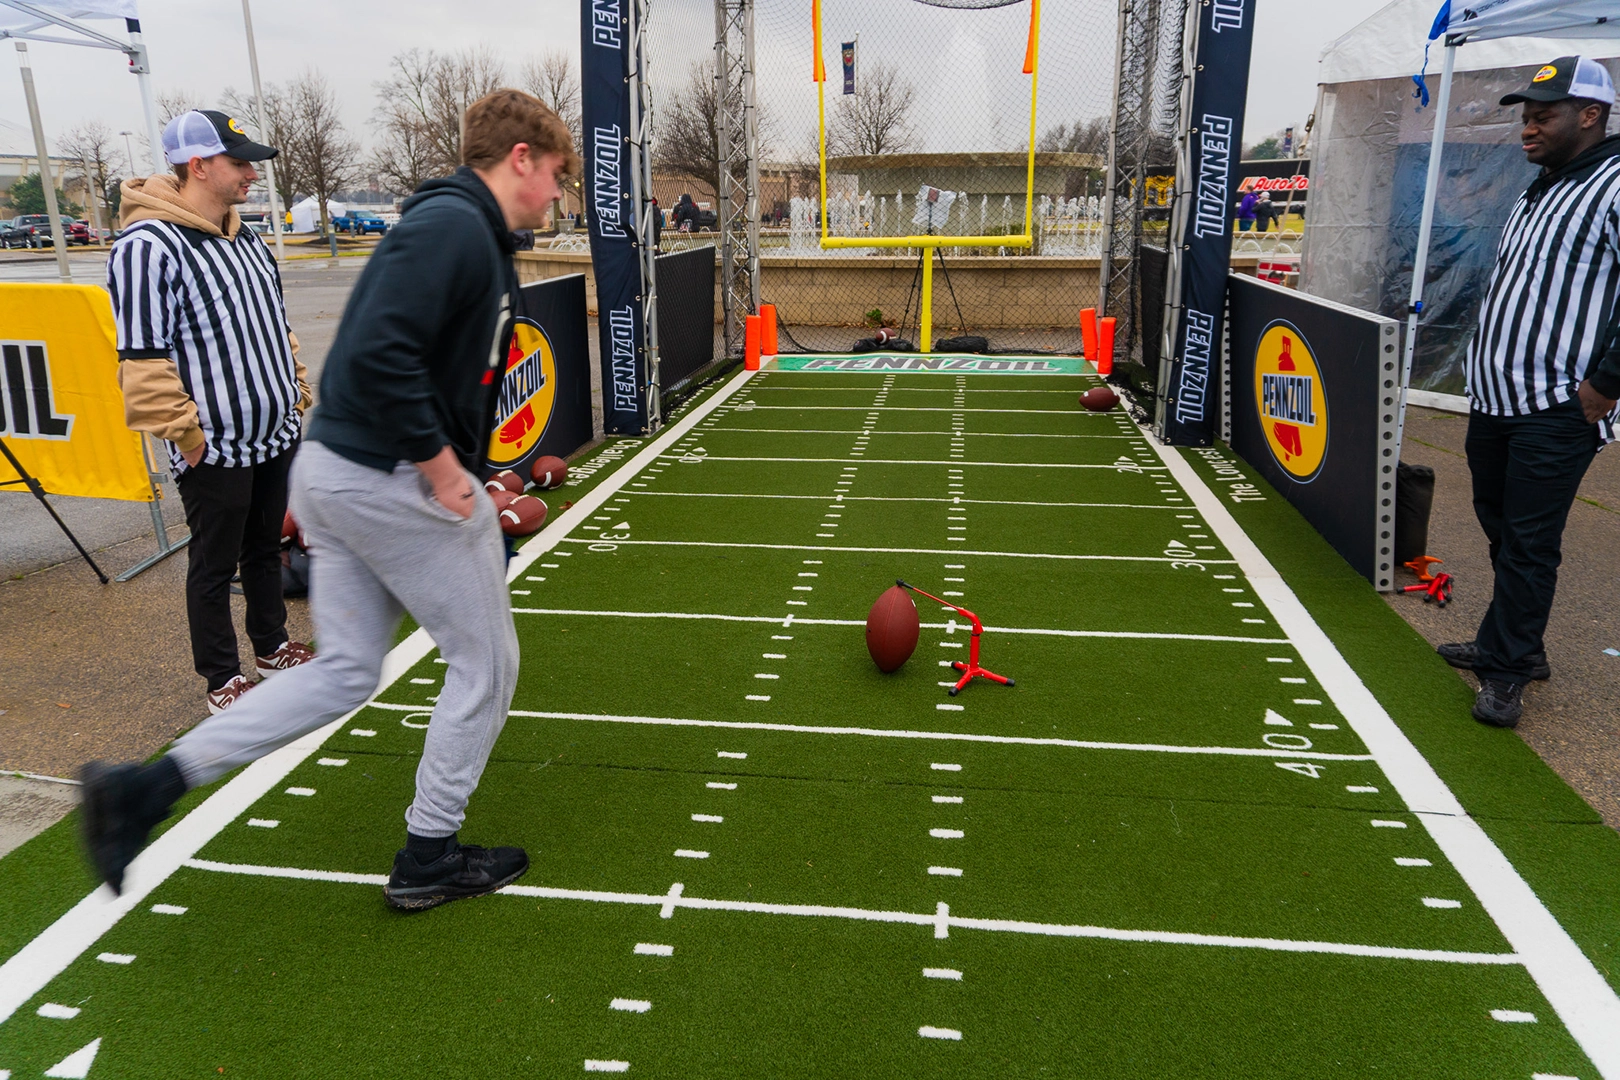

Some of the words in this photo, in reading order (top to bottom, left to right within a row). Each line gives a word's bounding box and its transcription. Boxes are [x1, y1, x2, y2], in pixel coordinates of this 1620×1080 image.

[594, 123, 628, 238] PENNZOIL
[1194, 113, 1233, 239] PENNZOIL
[1253, 174, 1309, 191] AutoZo
[610, 304, 638, 413] PENNZOIL
[800, 356, 1063, 373] PENNZOIL
[1176, 308, 1214, 424] PENNZOIL
[0, 339, 76, 442] IL
[491, 347, 546, 434] NNZOIL
[1262, 372, 1317, 427] PENNZOIL
[567, 439, 643, 479] Challenge
[1228, 483, 1267, 503] The
[588, 532, 631, 552] 30
[1163, 549, 1206, 571] 30
[1262, 733, 1327, 779] 40
